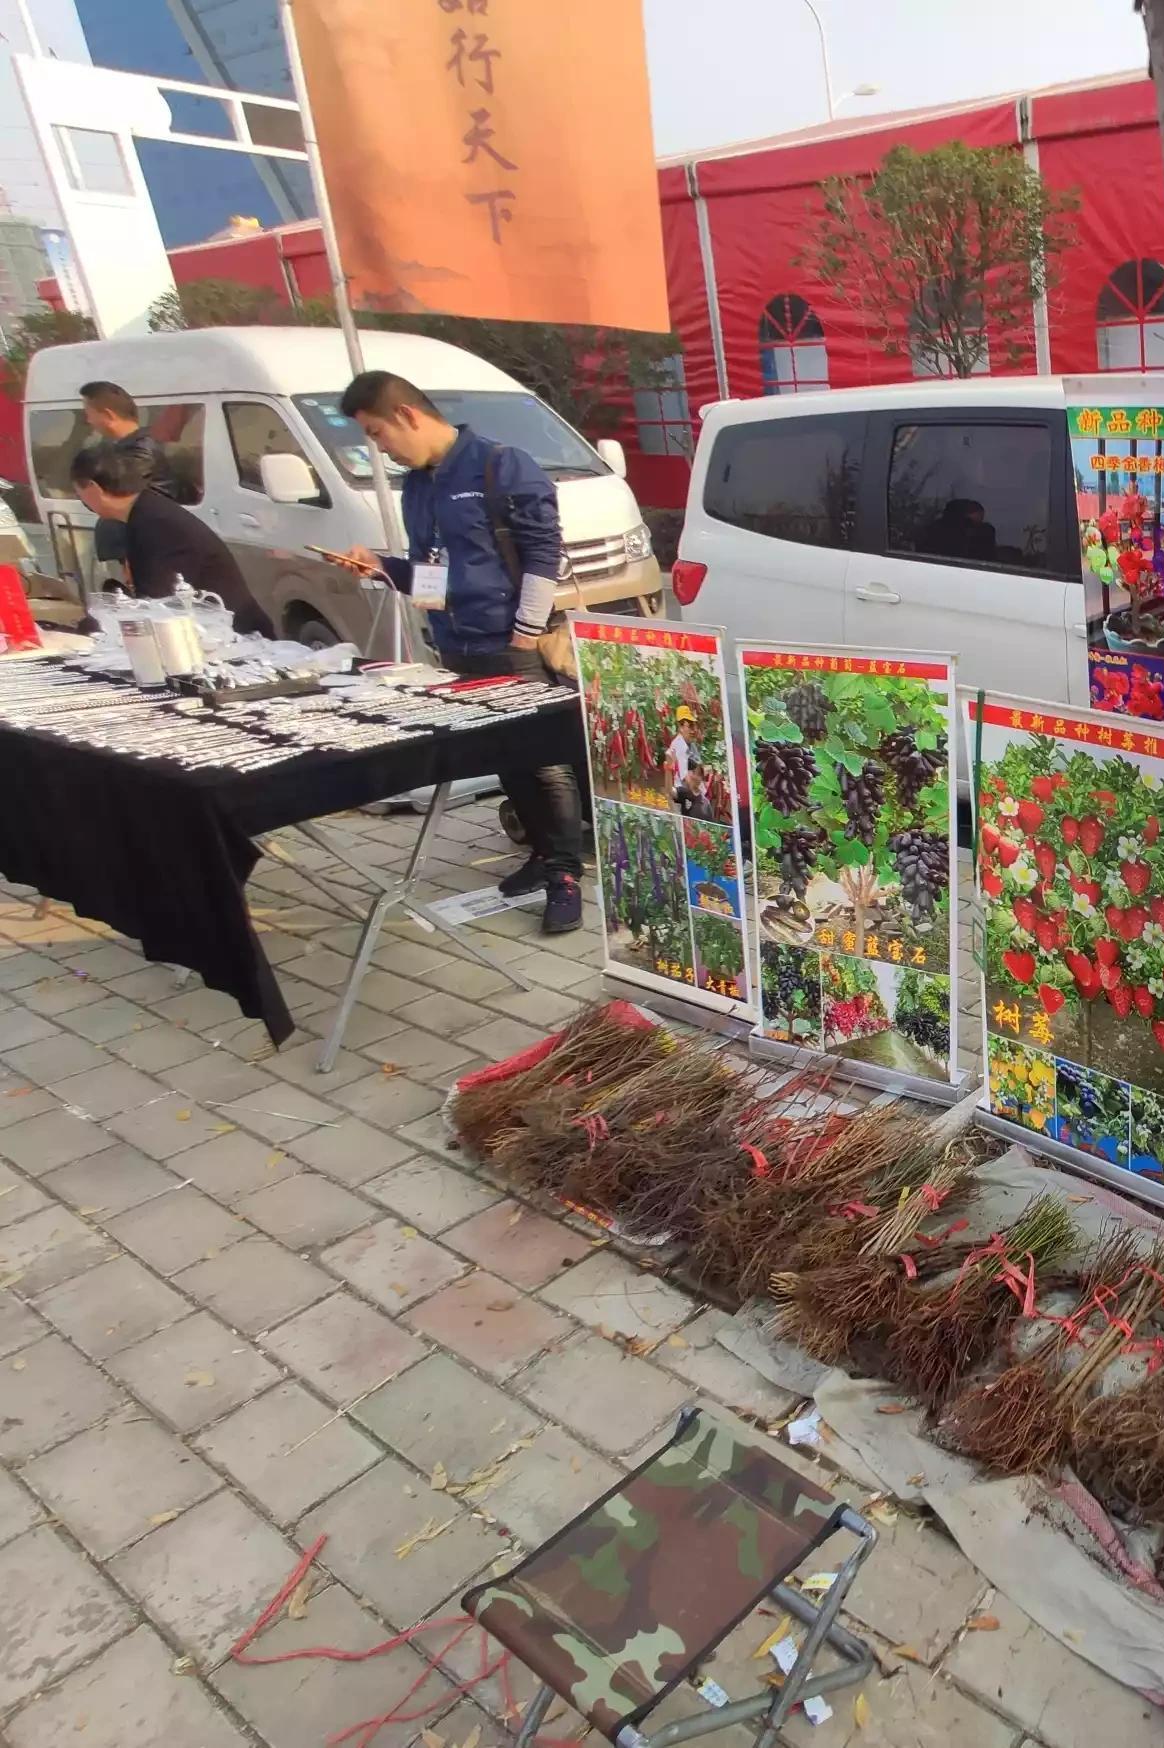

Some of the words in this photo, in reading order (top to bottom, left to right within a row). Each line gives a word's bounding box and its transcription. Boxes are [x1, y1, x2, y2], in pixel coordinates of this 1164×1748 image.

[817, 928, 928, 965] 甜蜜蓝宝石
[993, 1000, 1055, 1045] 树莓
